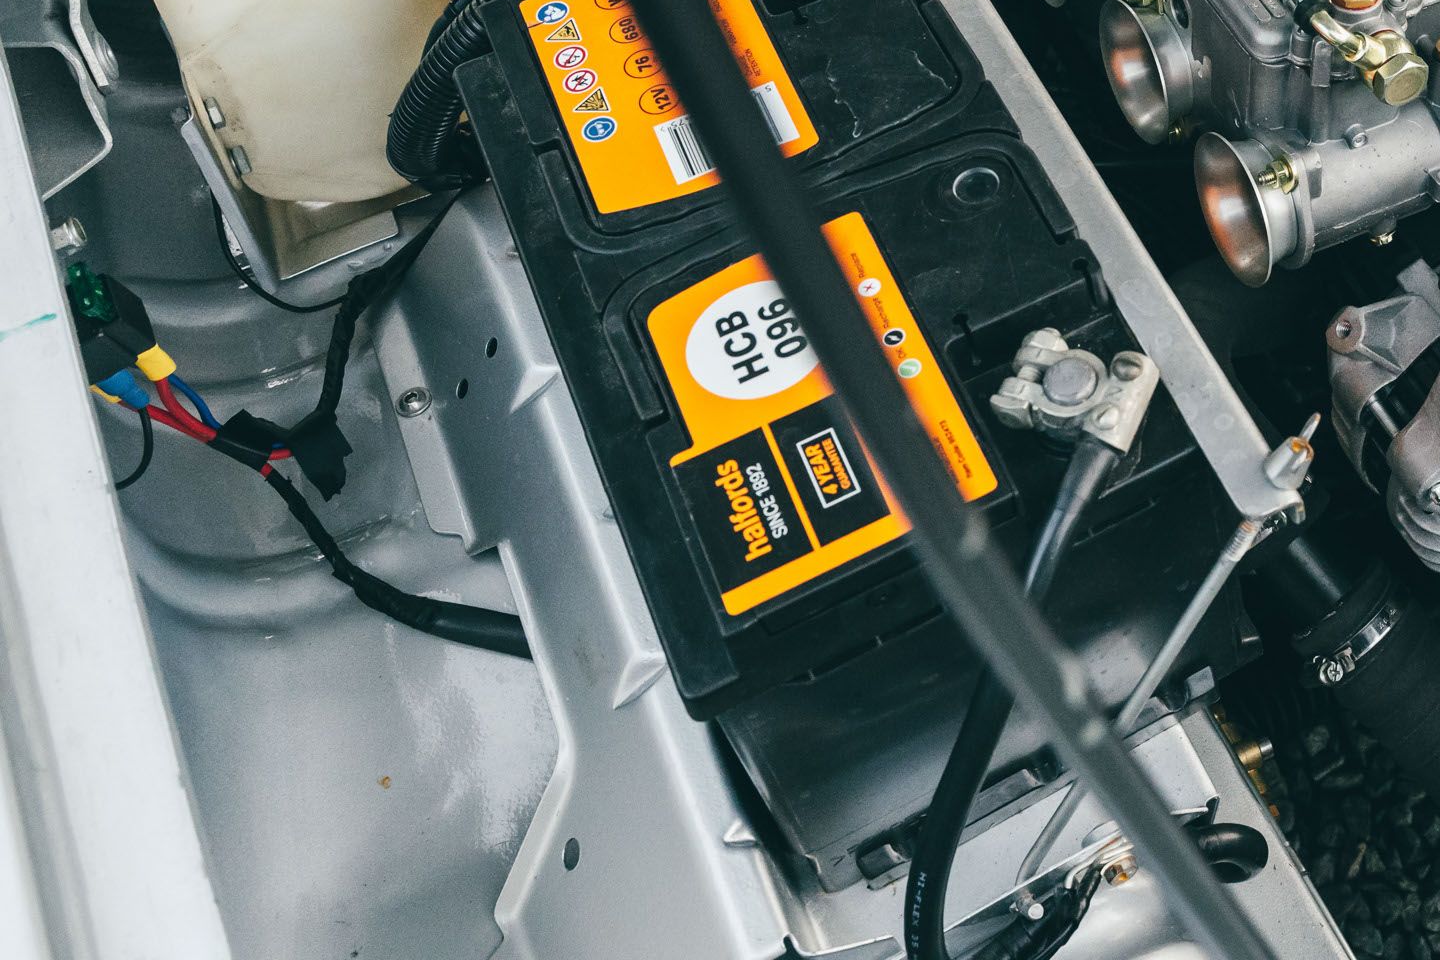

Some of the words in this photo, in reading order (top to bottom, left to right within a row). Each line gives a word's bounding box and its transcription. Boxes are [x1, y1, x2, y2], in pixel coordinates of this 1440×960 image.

[619, 18, 639, 41] 680
[635, 55, 653, 73] 76
[745, 48, 761, 77] RETENTION
[651, 88, 671, 110] 12V
[850, 252, 865, 279] Replace
[758, 297, 810, 359] 096
[873, 296, 890, 329] Recharge
[715, 309, 770, 385] HCB
[745, 462, 771, 494] 1892
[805, 443, 834, 483] YEAR
[821, 437, 852, 490] GUARANTEE
[821, 481, 839, 496] 4
[714, 459, 773, 562] halfords
[759, 494, 789, 540] SINCE
